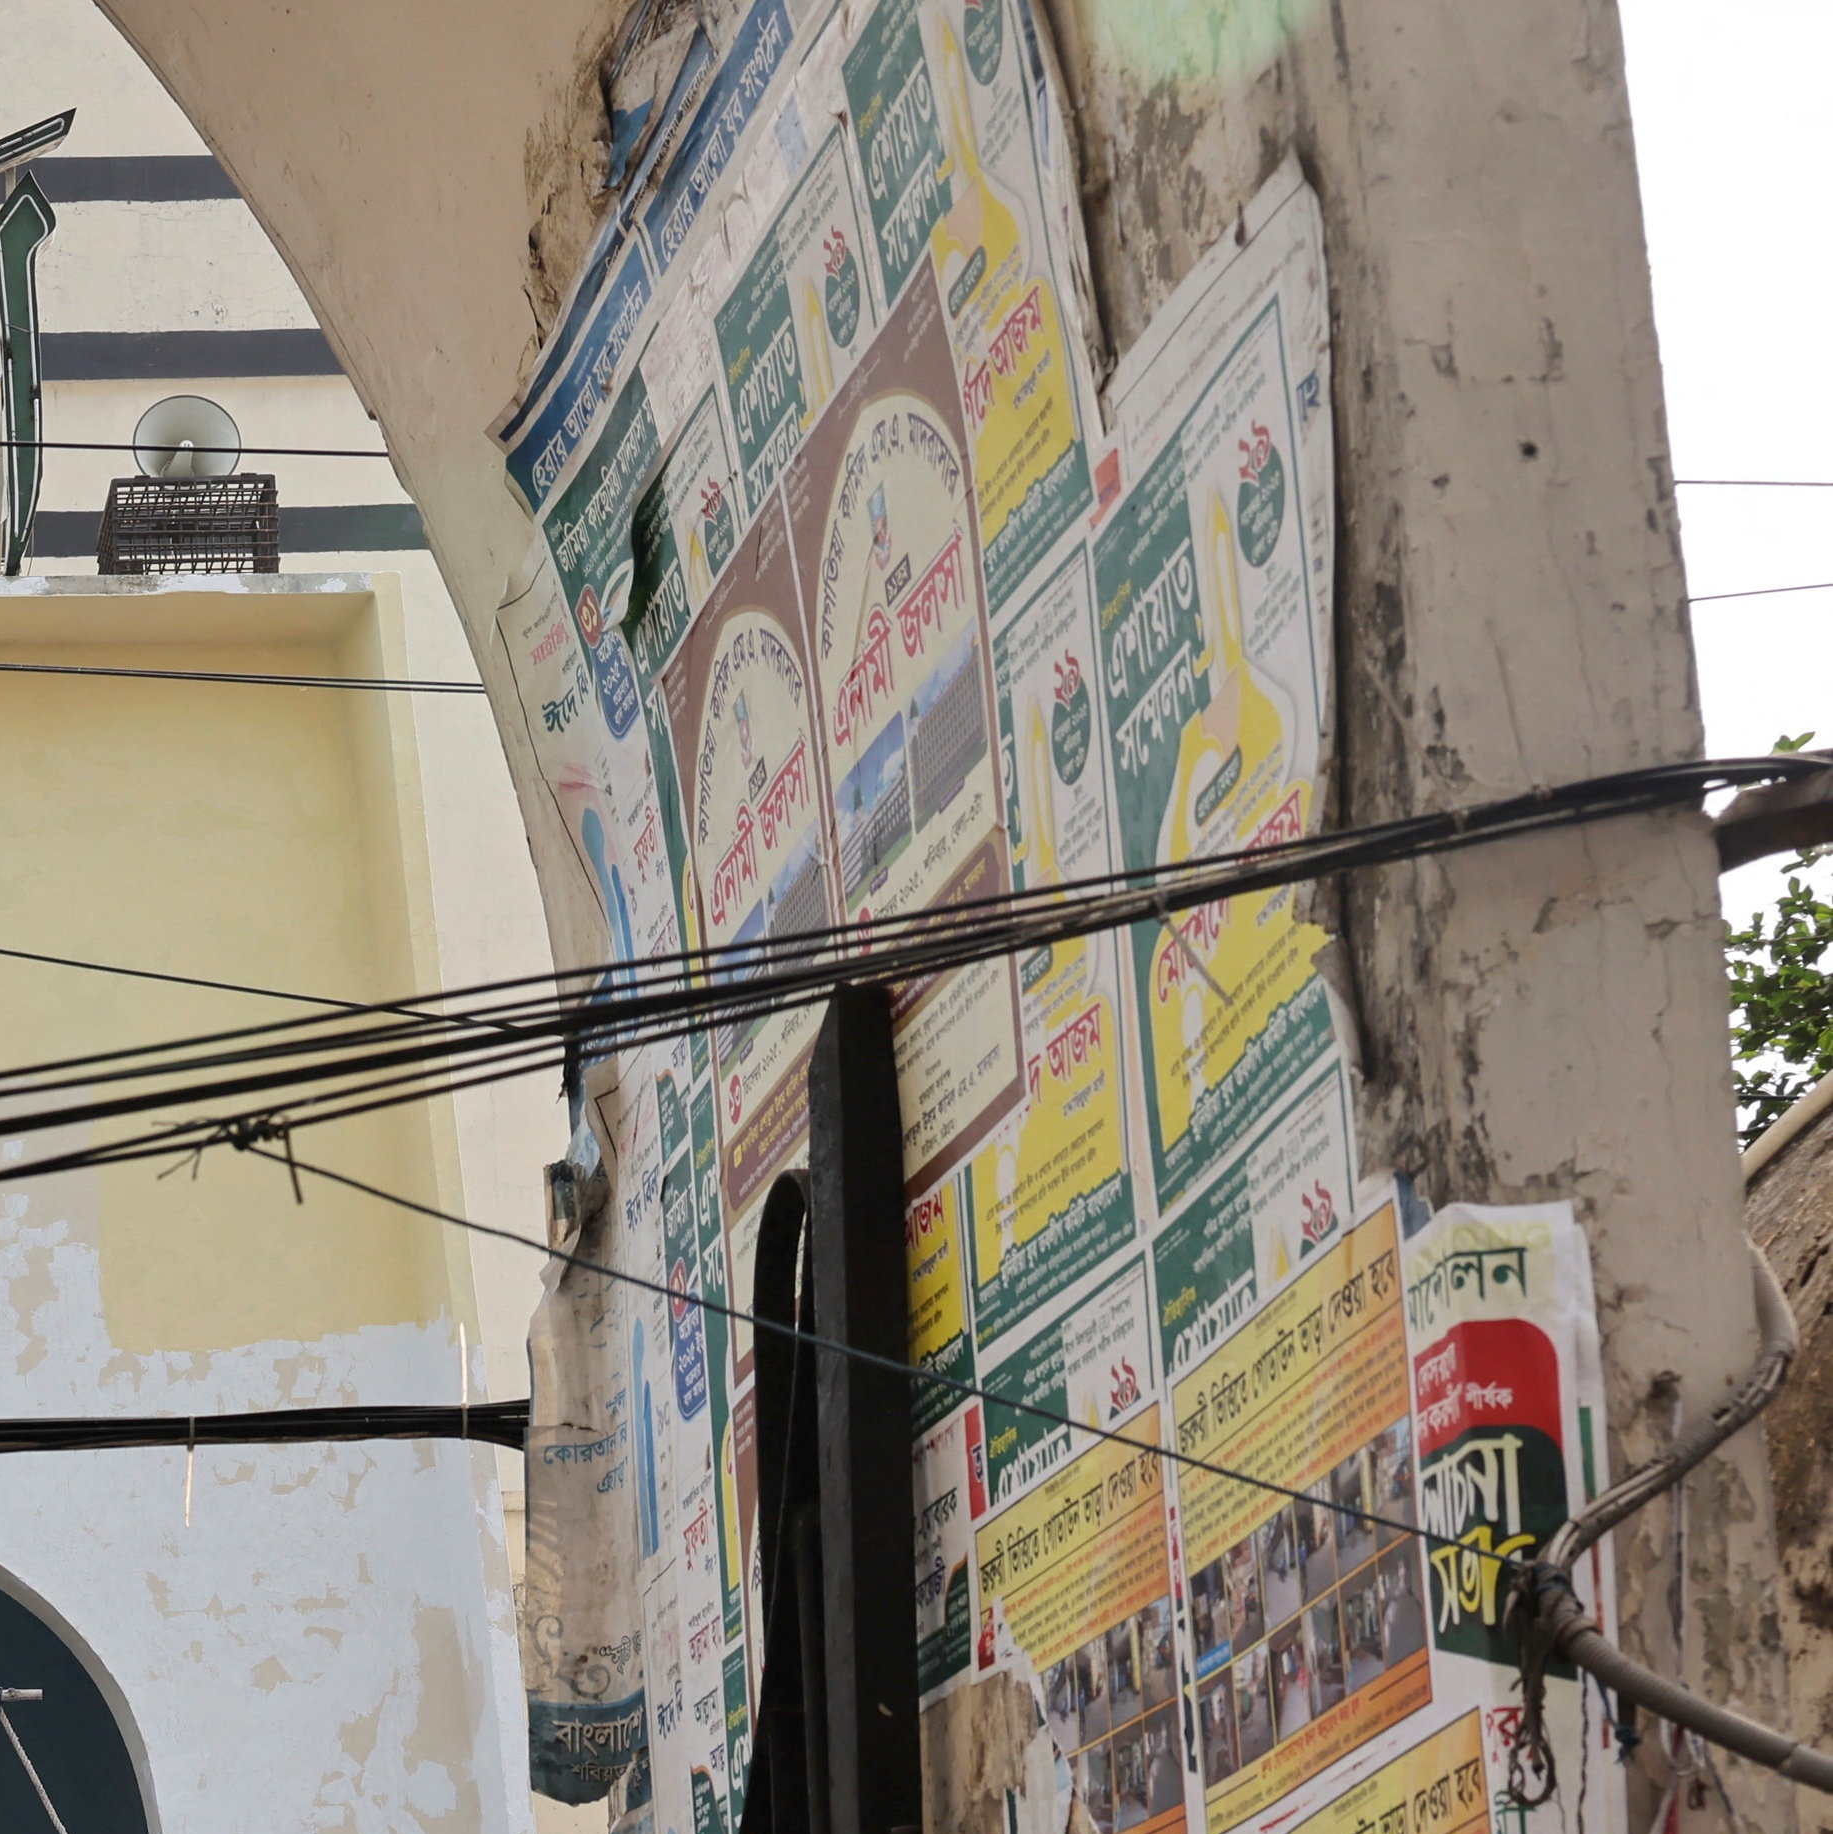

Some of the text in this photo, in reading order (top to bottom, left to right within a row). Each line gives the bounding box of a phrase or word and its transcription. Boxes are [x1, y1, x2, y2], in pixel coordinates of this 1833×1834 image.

[868, 58, 933, 200] এশায়াত
[737, 317, 796, 446] এশায়াত
[1107, 536, 1193, 700] এশায়াত
[1115, 639, 1198, 777] সম্মেলন
[1046, 1003, 1101, 1081] আজম
[1368, 1248, 1396, 1303] হবে
[1430, 1526, 1537, 1634] সভা
[1454, 1757, 1482, 1810] হবে
